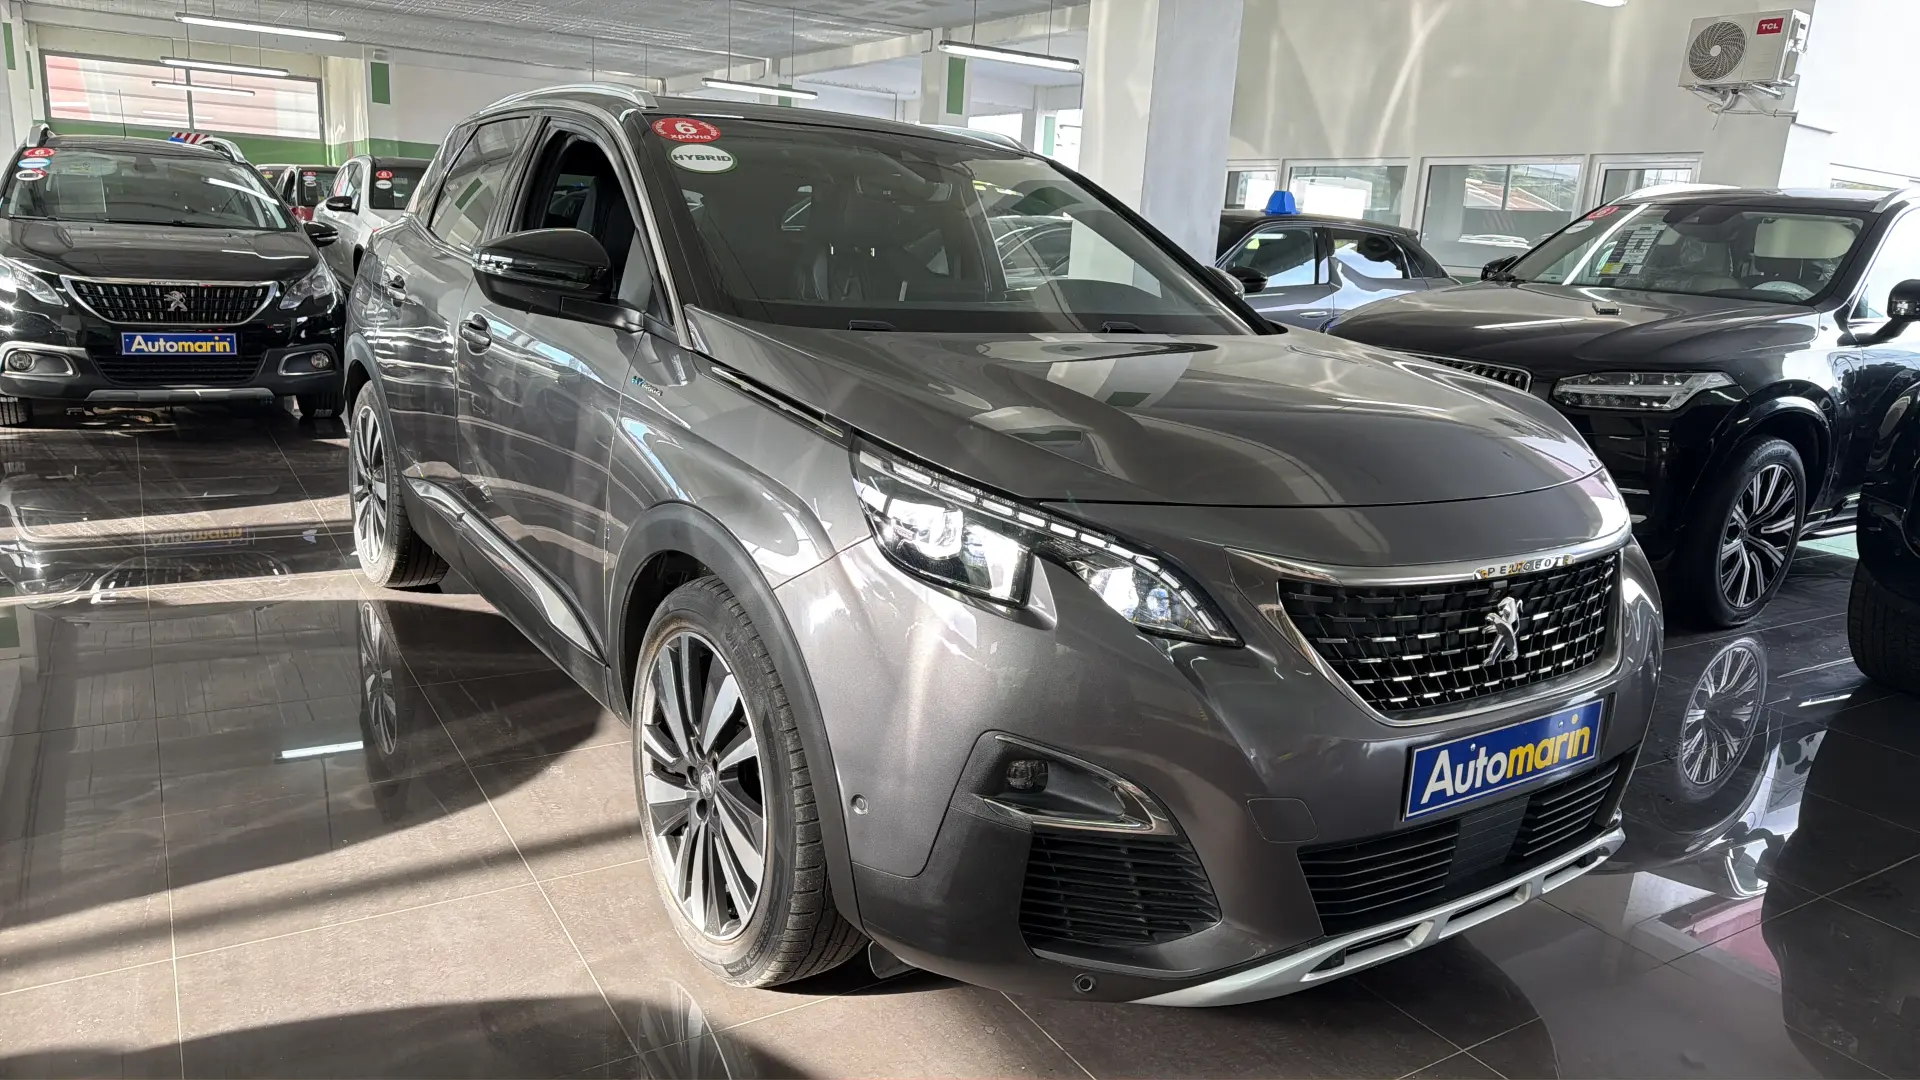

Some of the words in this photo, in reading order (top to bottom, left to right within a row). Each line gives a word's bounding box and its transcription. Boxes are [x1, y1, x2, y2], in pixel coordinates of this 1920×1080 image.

[675, 122, 698, 134] 6
[673, 154, 732, 162] HYBRID
[130, 335, 231, 353] Automarin
[1487, 556, 1562, 577] PEUGEOT
[1420, 713, 1590, 805] Automarin
